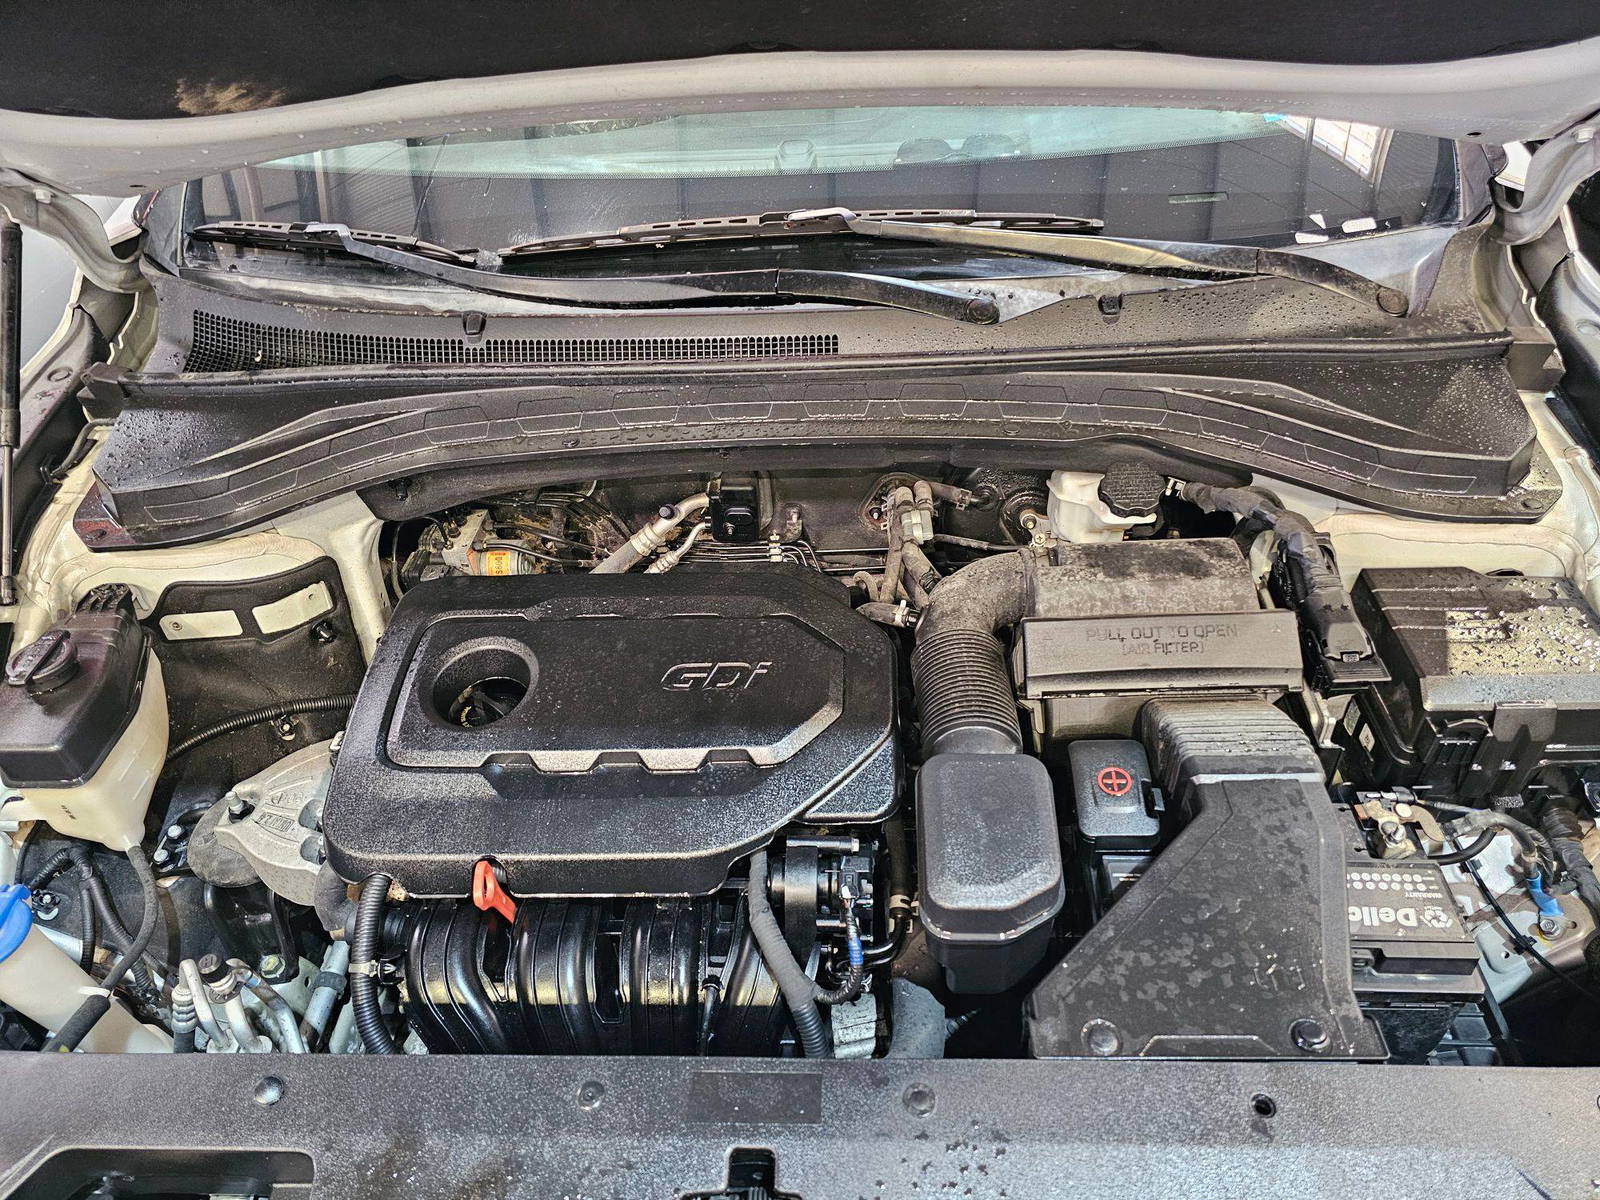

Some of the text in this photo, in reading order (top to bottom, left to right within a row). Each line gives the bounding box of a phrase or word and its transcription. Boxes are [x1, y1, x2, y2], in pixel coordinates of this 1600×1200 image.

[1086, 624, 1238, 642] PULL OUT TO OPEN
